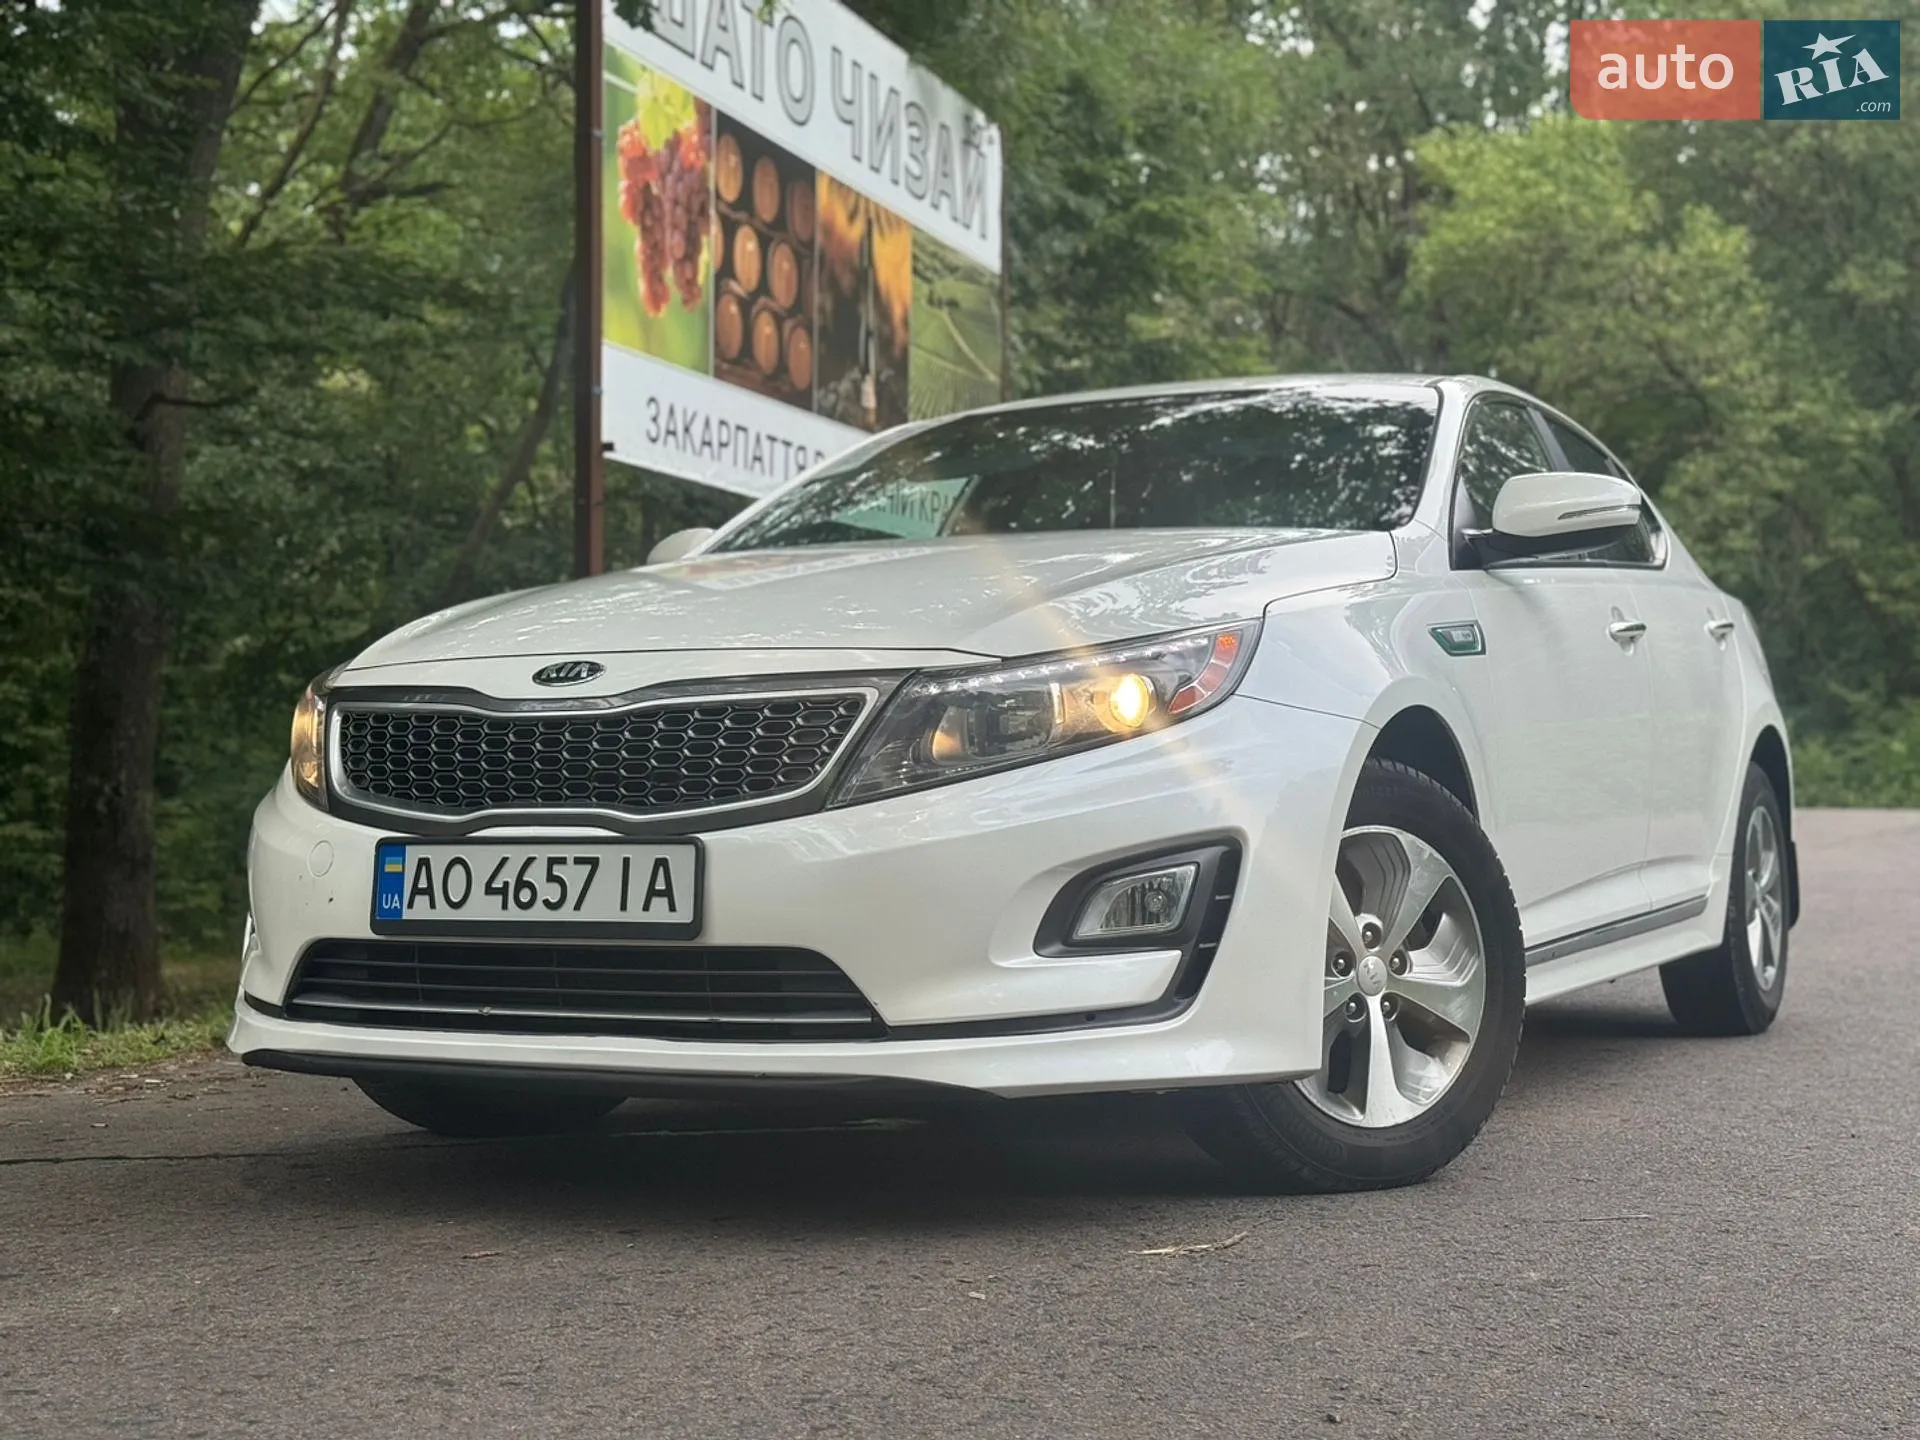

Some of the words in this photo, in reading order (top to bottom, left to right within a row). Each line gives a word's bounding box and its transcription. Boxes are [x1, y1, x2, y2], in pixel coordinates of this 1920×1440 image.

[829, 45, 987, 240] ЧИЗАЙ
[646, 396, 808, 482] ЗАКАРПАТТЯ
[382, 893, 400, 909] UA
[407, 856, 473, 910] AO
[484, 855, 600, 911] 4657
[620, 856, 678, 912] IA
